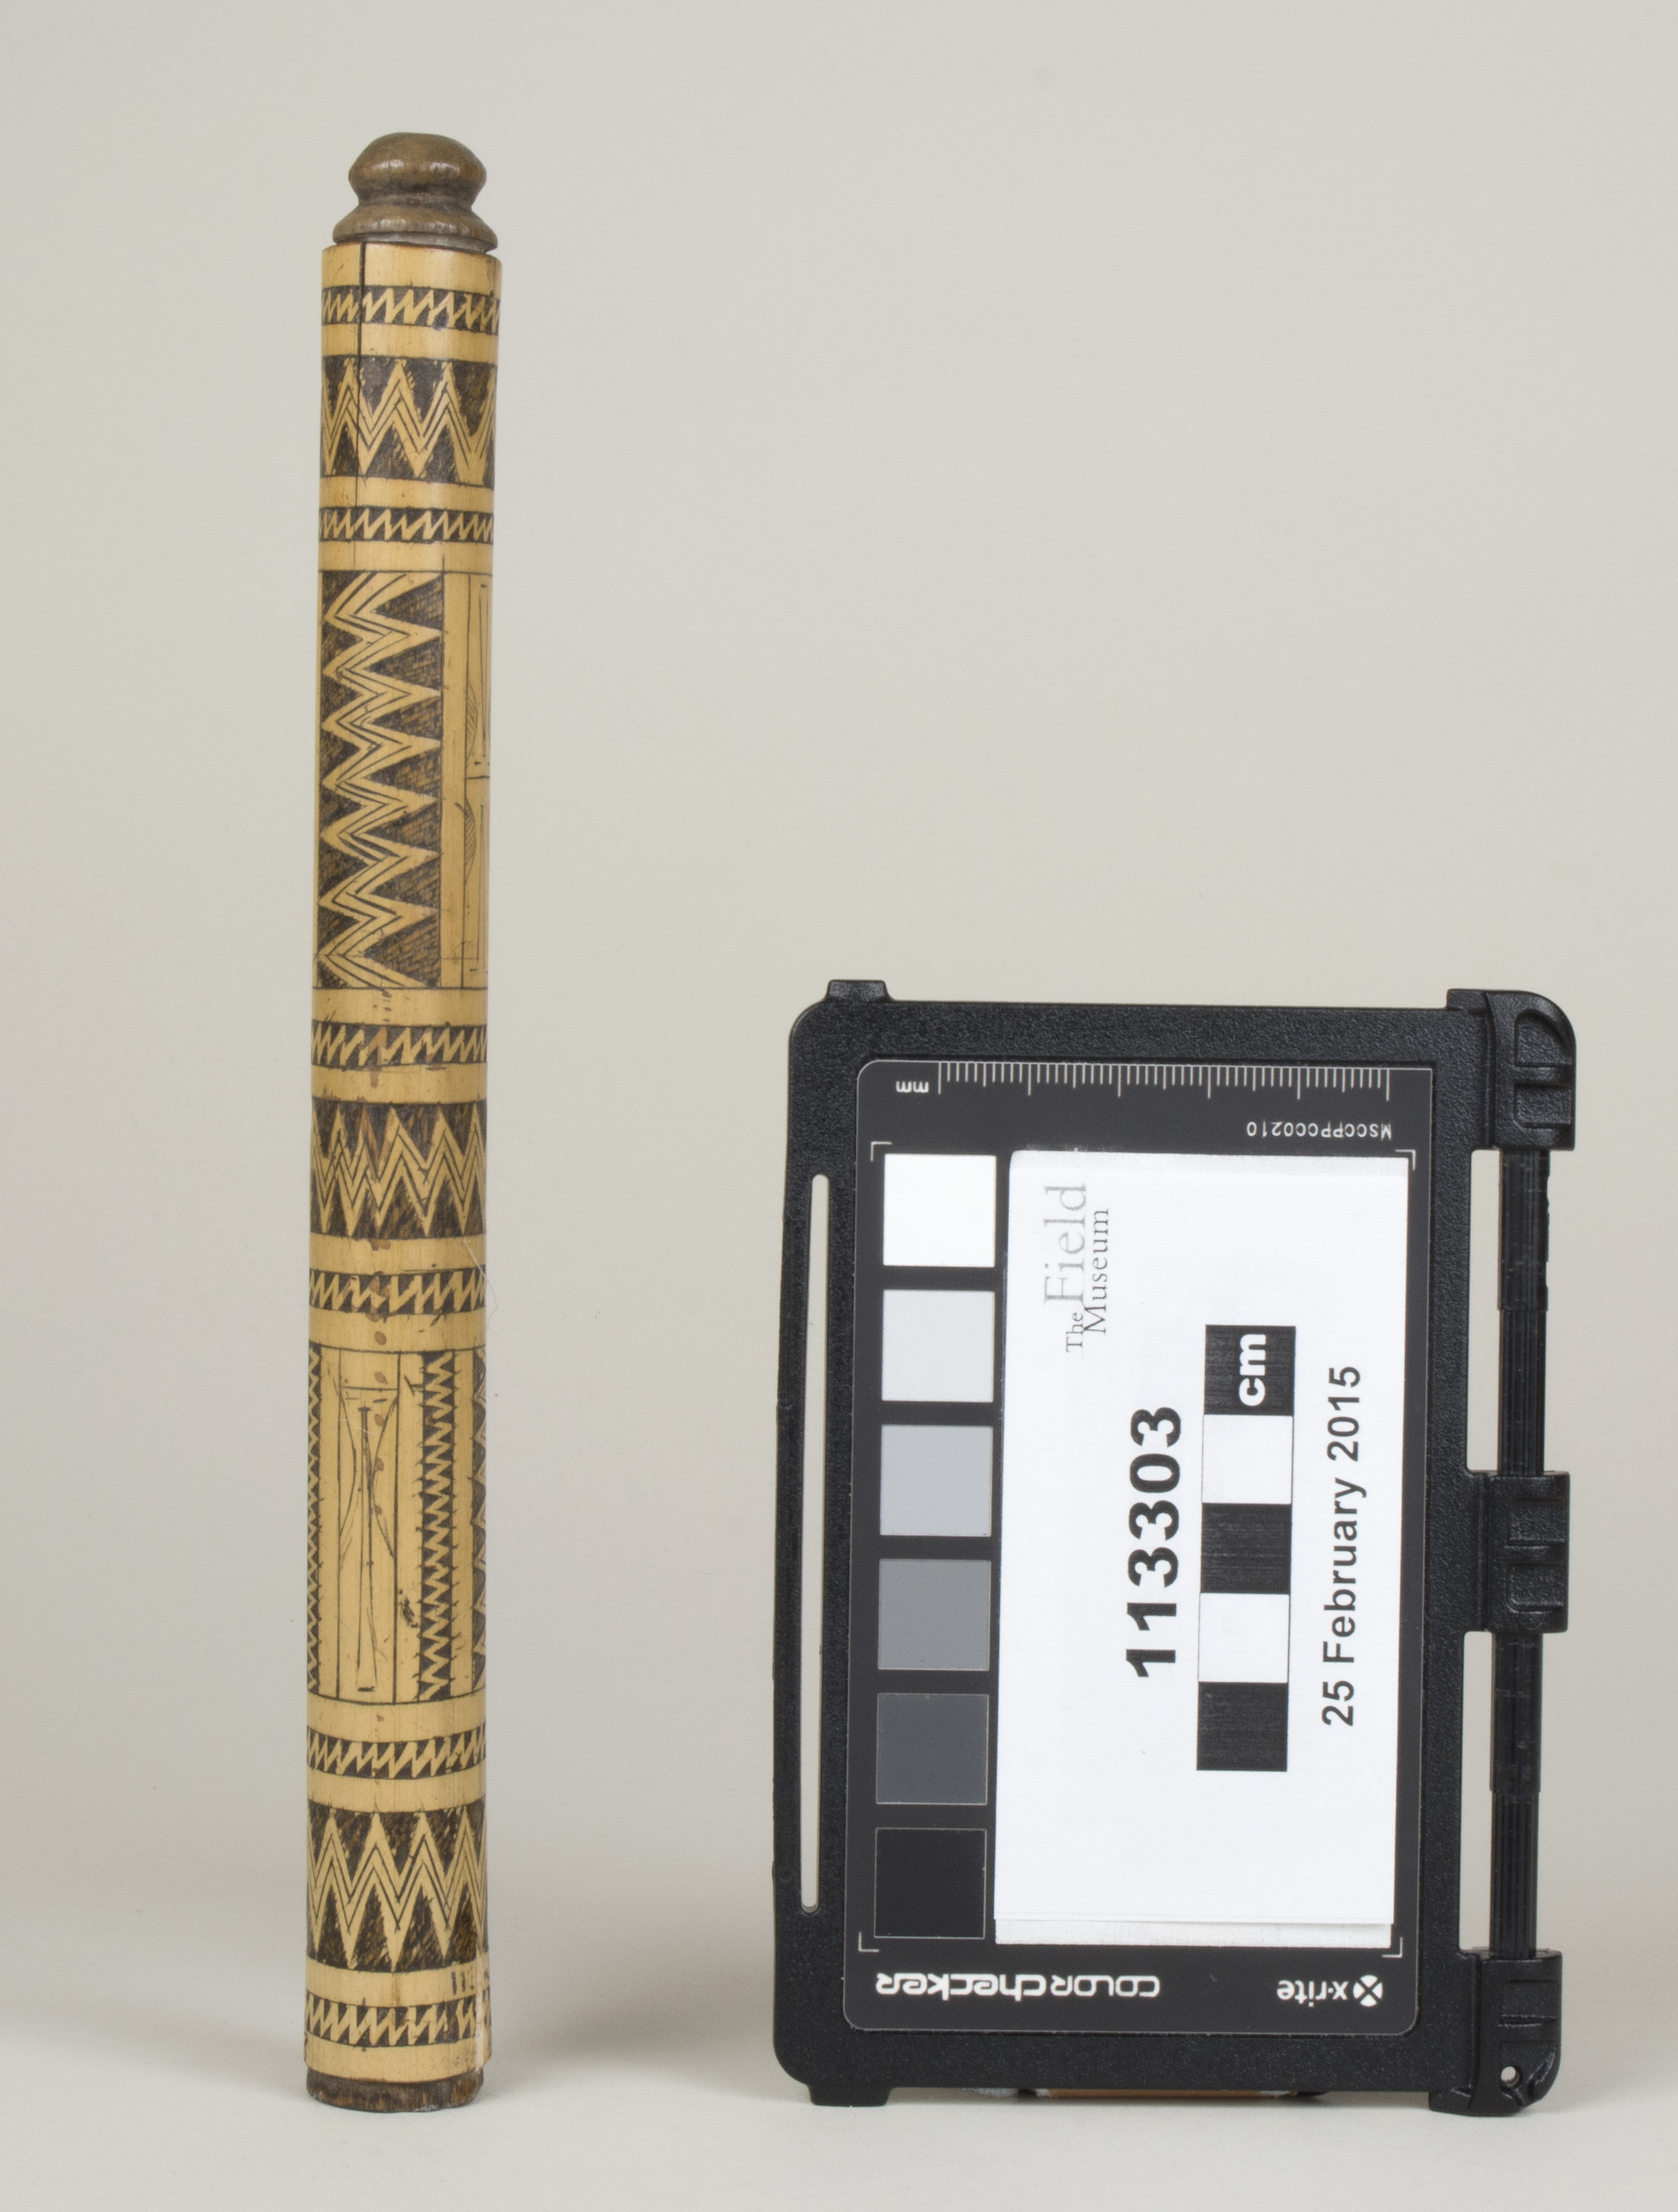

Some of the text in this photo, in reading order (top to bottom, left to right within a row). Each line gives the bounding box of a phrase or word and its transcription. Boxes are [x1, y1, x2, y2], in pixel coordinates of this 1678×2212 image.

[895, 1080, 929, 1094] mm
[1043, 1183, 1087, 1352] The Field
[1083, 1208, 1108, 1335] Museum
[1238, 1333, 1267, 1406] cm
[1126, 1407, 1180, 1677] 113303
[1322, 1366, 1366, 1727] 25 February 2015
